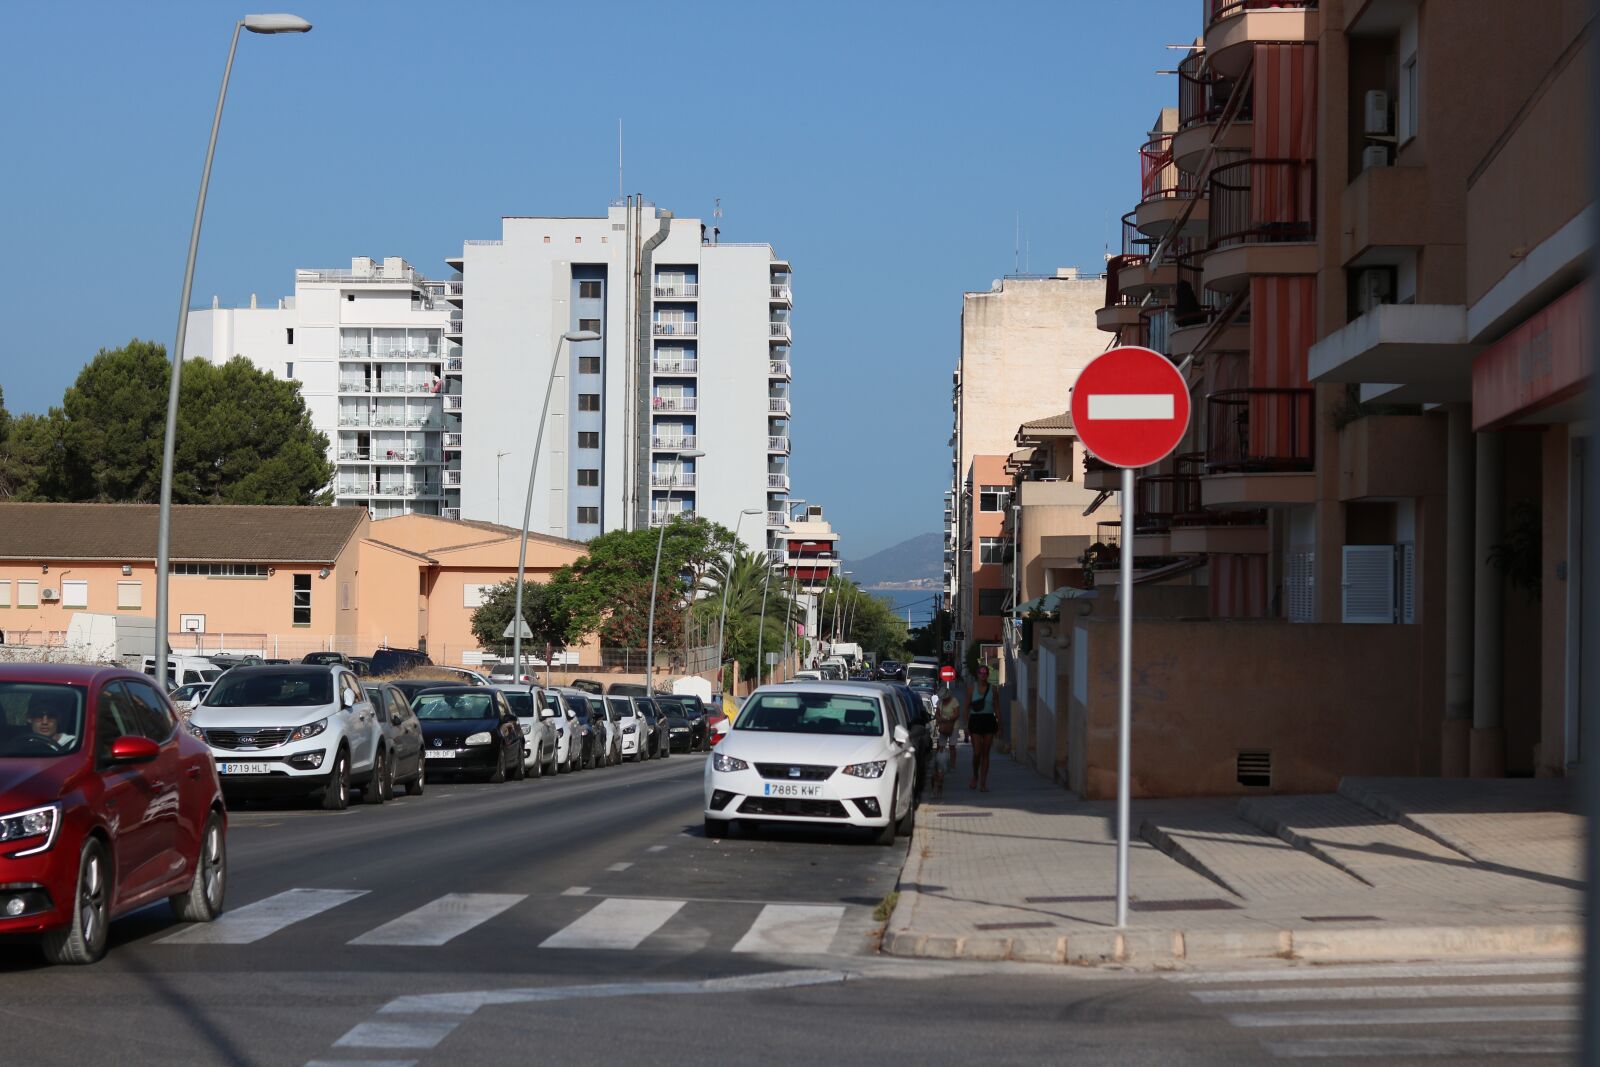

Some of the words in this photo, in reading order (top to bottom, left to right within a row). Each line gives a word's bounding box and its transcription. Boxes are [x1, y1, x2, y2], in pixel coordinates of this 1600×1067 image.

[227, 764, 250, 773] 8719
[252, 763, 268, 772] HLT
[772, 784, 798, 796] 7885
[801, 785, 821, 796] KWF
